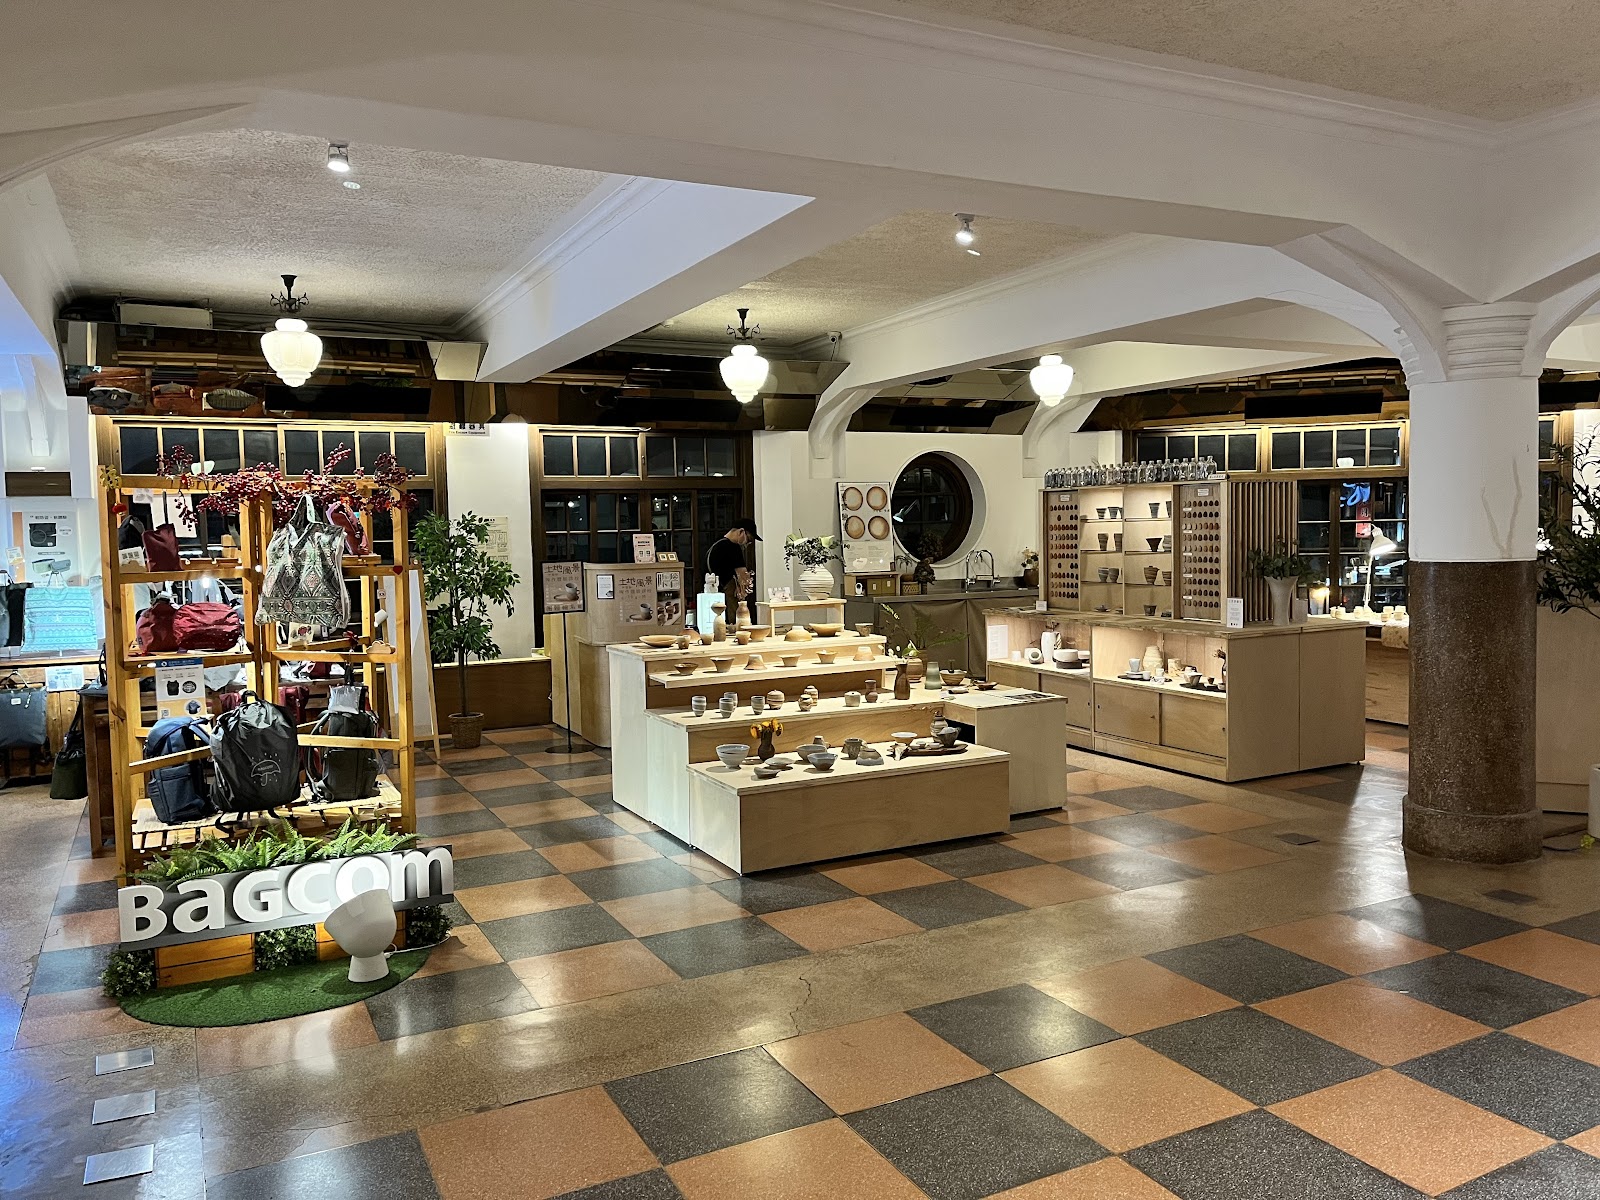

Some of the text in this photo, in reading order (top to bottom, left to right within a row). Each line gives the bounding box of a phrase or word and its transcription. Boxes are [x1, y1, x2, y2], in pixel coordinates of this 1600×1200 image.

[544, 563, 580, 574] 土地風景
[618, 576, 652, 587] 土地風景
